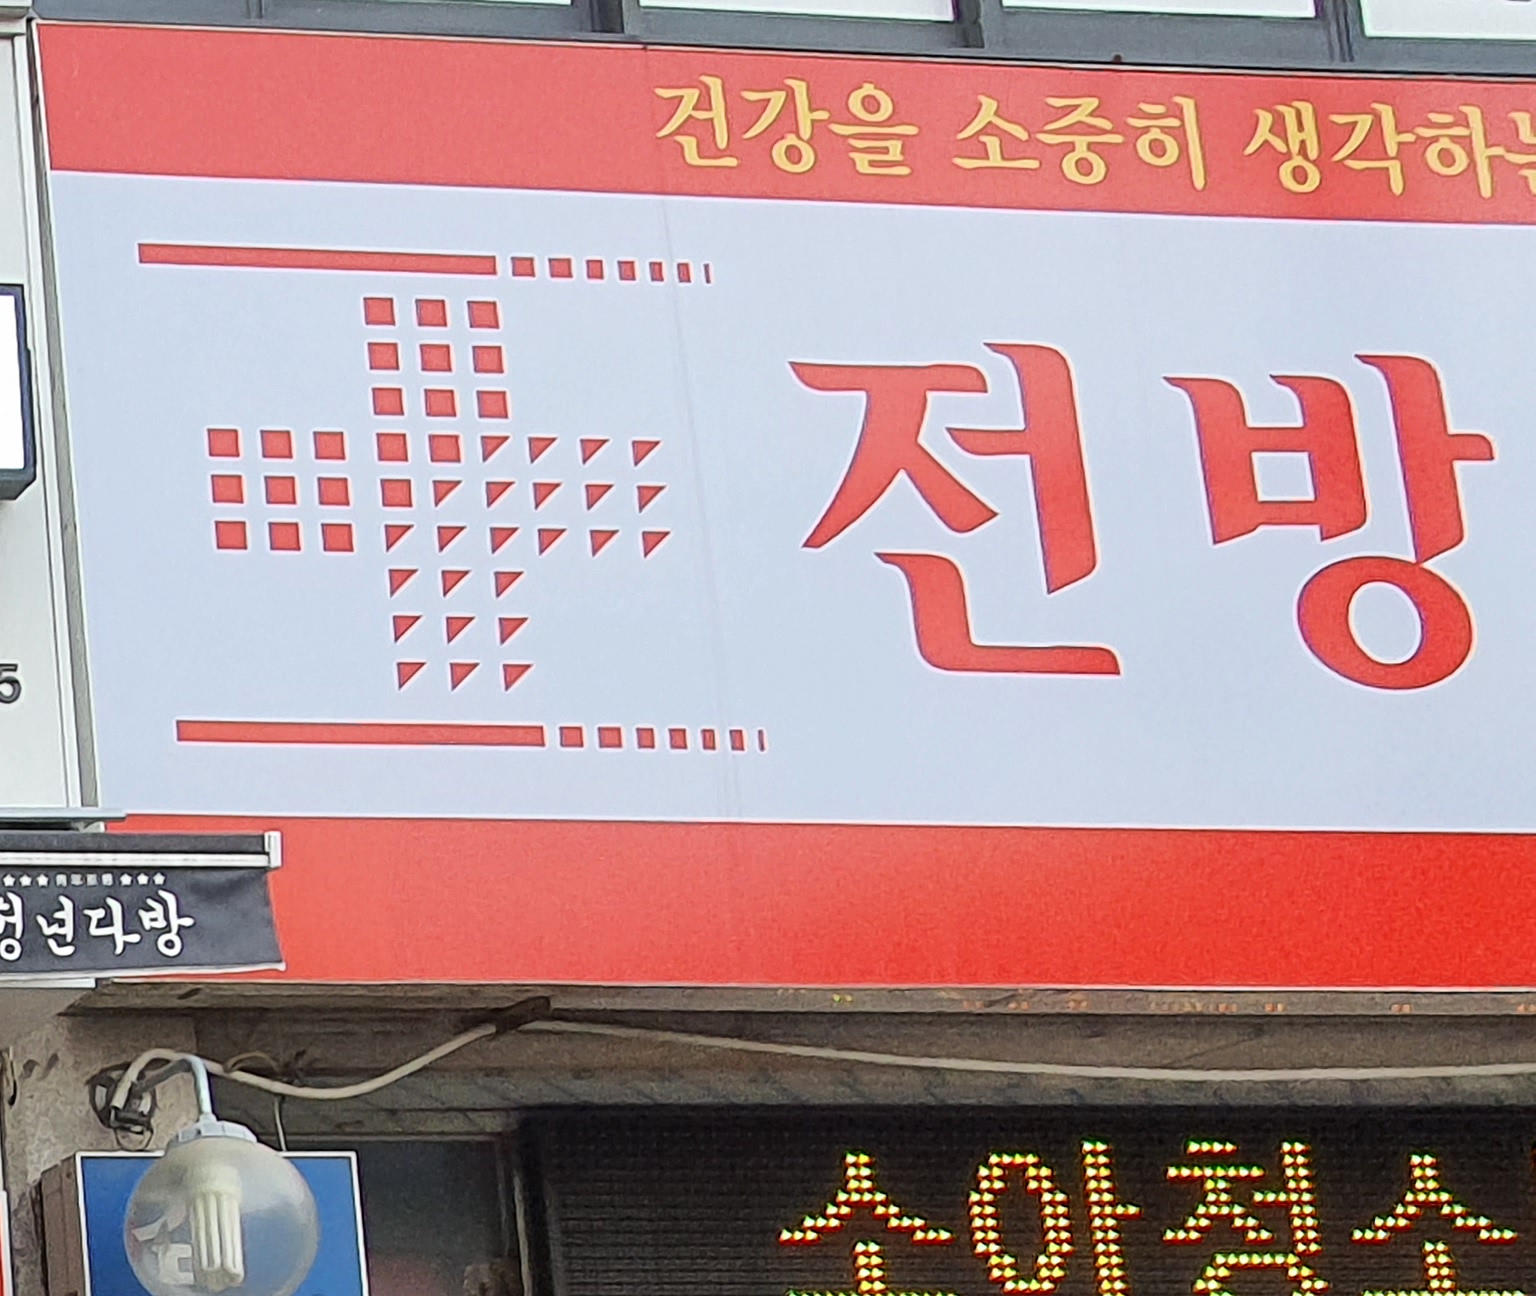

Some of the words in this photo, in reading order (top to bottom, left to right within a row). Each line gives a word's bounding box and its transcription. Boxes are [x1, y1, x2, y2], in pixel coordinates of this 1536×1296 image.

[655, 76, 918, 175] 건강을
[951, 96, 1206, 191] 소중히
[789, 341, 1495, 691] 전방
